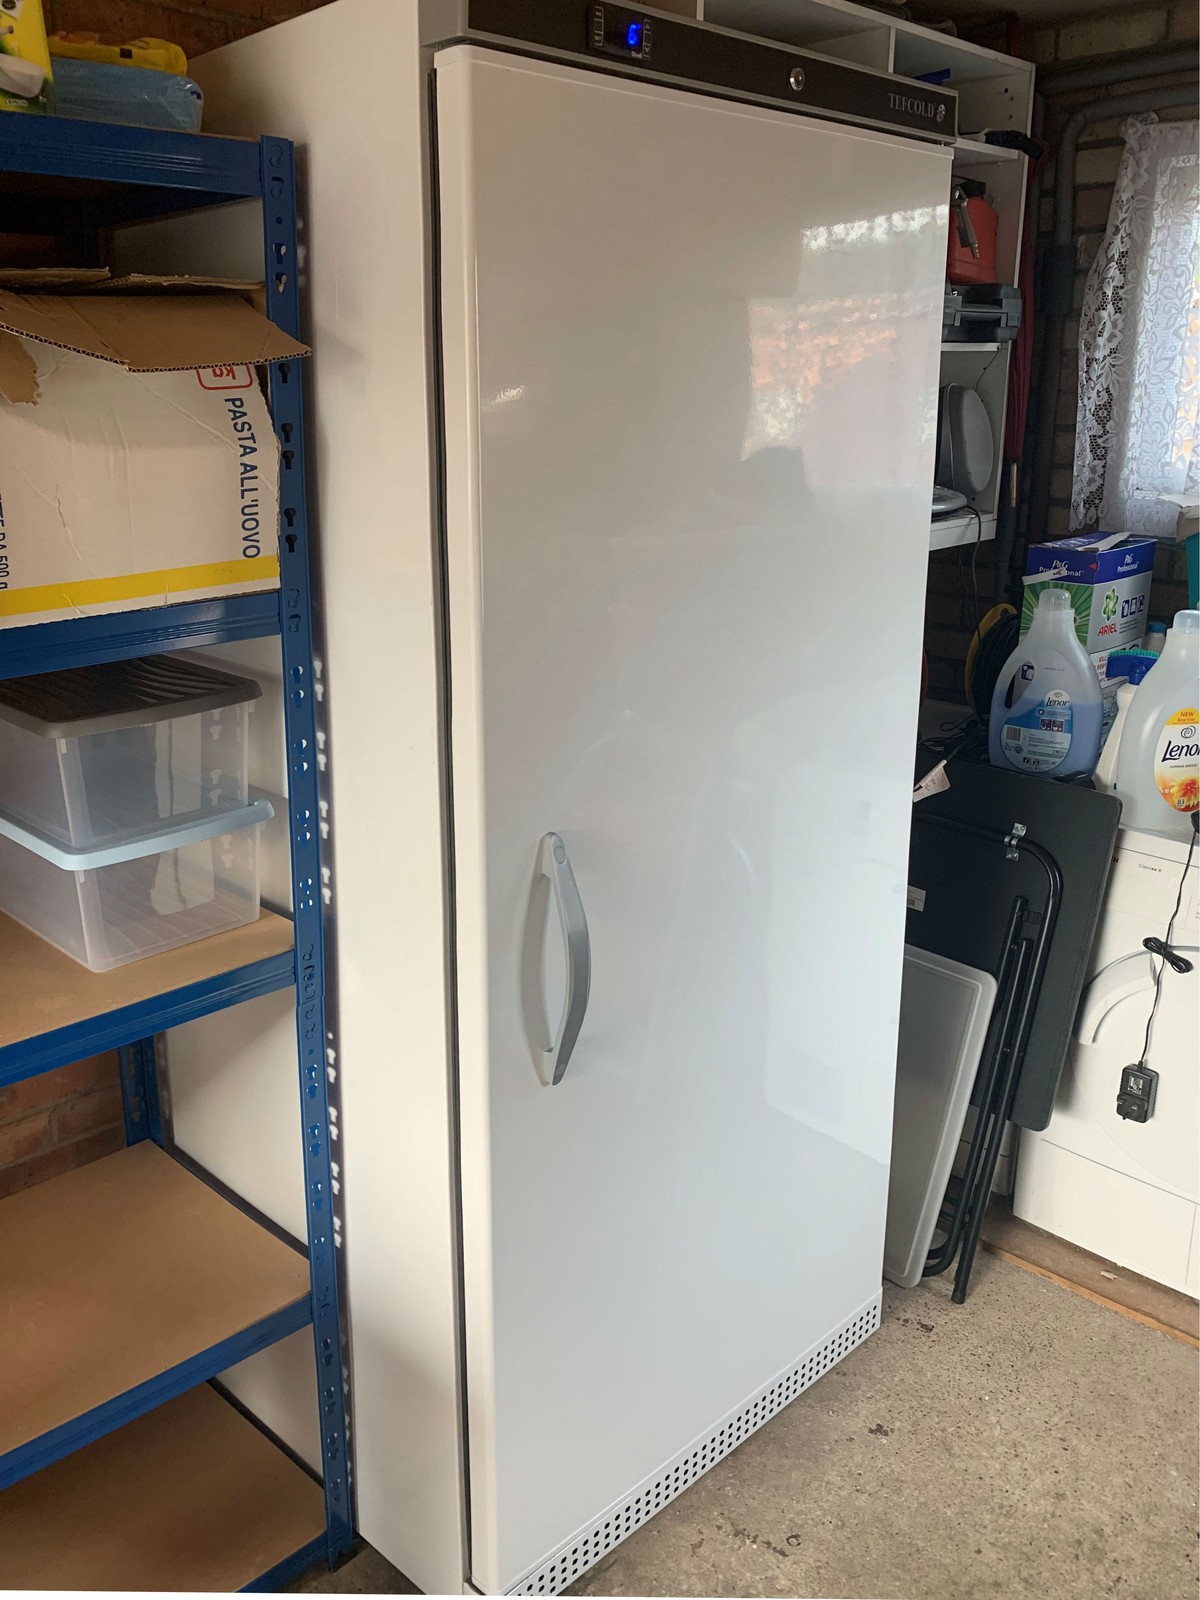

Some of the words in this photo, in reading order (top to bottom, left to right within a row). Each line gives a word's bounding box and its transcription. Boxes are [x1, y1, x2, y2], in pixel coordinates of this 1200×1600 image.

[888, 93, 935, 117] TEFCOLD
[224, 397, 258, 458] PASTA
[239, 462, 261, 559] ALL'UOVO
[1052, 559, 1069, 569] P&G
[1125, 553, 1134, 563] P&G
[1097, 623, 1118, 637] ARIEL
[1046, 697, 1070, 707] Lenor
